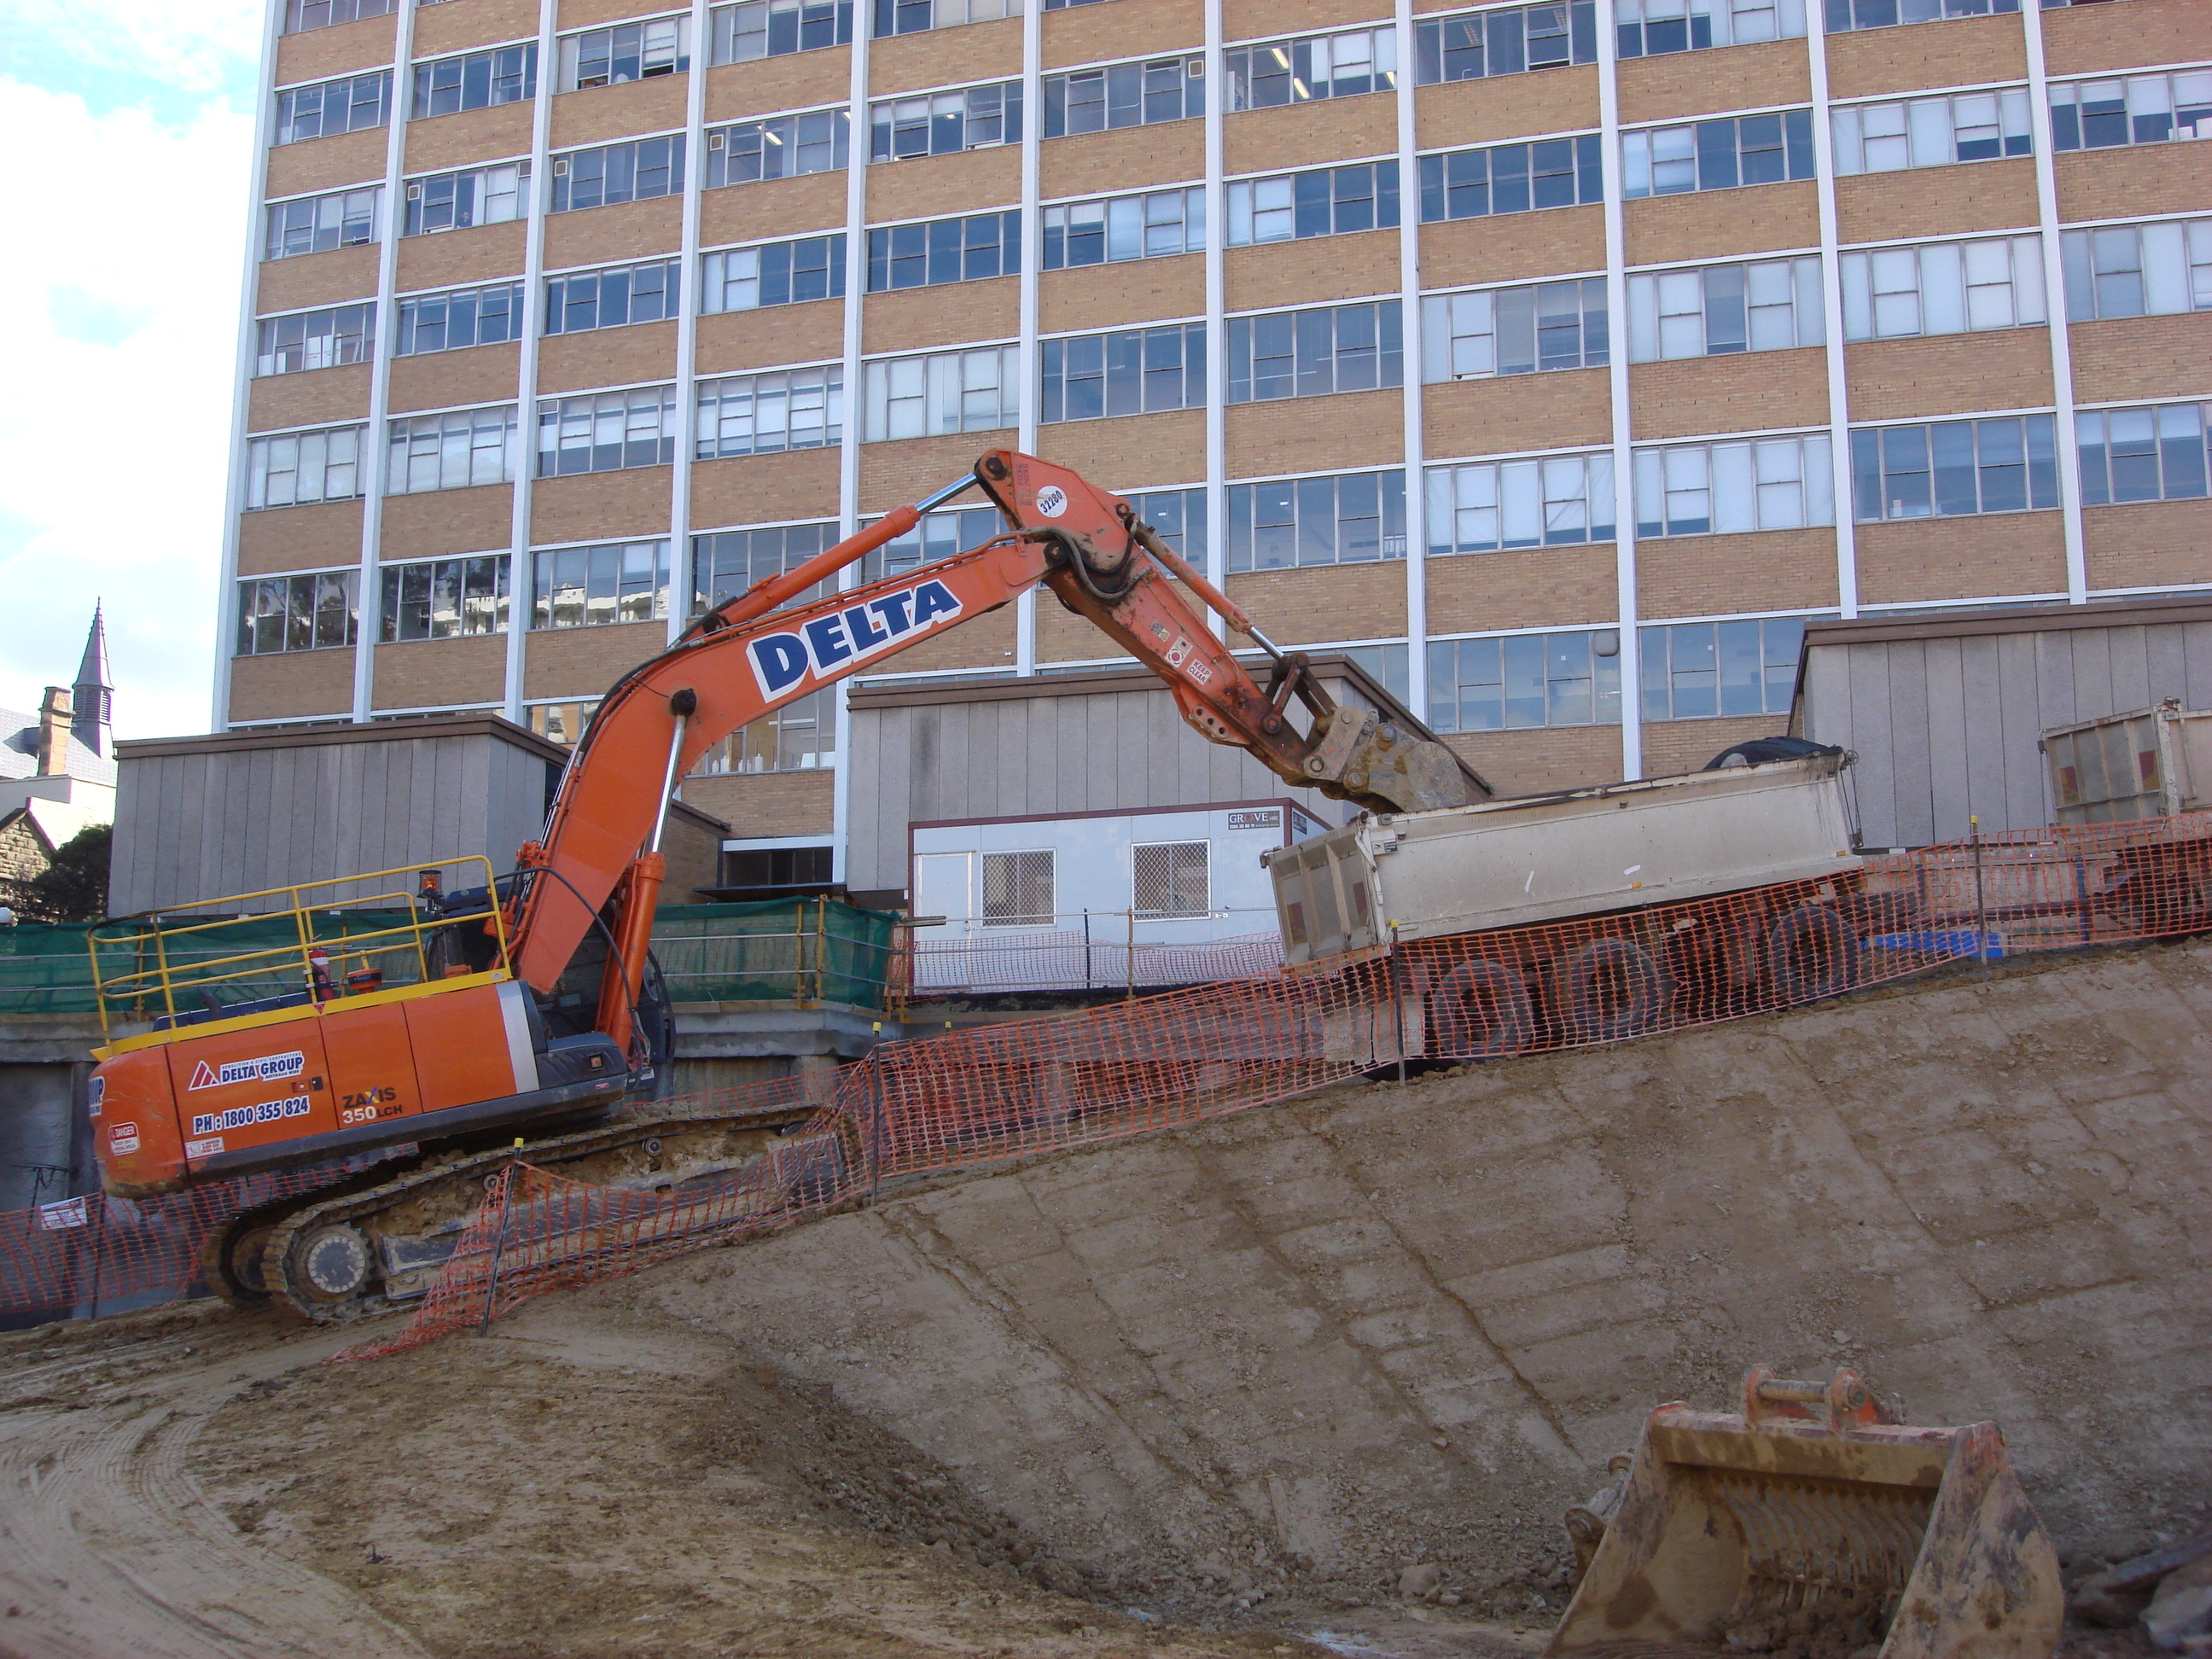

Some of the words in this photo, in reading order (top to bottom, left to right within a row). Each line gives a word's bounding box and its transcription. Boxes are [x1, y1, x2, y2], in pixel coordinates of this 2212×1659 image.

[1040, 490, 1063, 513] 32280
[750, 580, 961, 695] DELTA
[1189, 667, 1206, 683] CLEAR
[1193, 661, 1210, 675] KEEP
[1230, 812, 1268, 824] GROVE
[222, 1061, 249, 1069] DEMOLITION
[269, 1051, 301, 1061] CONTRACTORS
[222, 1065, 256, 1083] DELTA
[260, 1057, 303, 1075] GROUP
[342, 1086, 397, 1109] ZAXIS
[224, 1107, 253, 1126] 1800
[258, 1102, 282, 1121] 355
[285, 1097, 308, 1115] 824
[115, 1126, 136, 1138] DANGER
